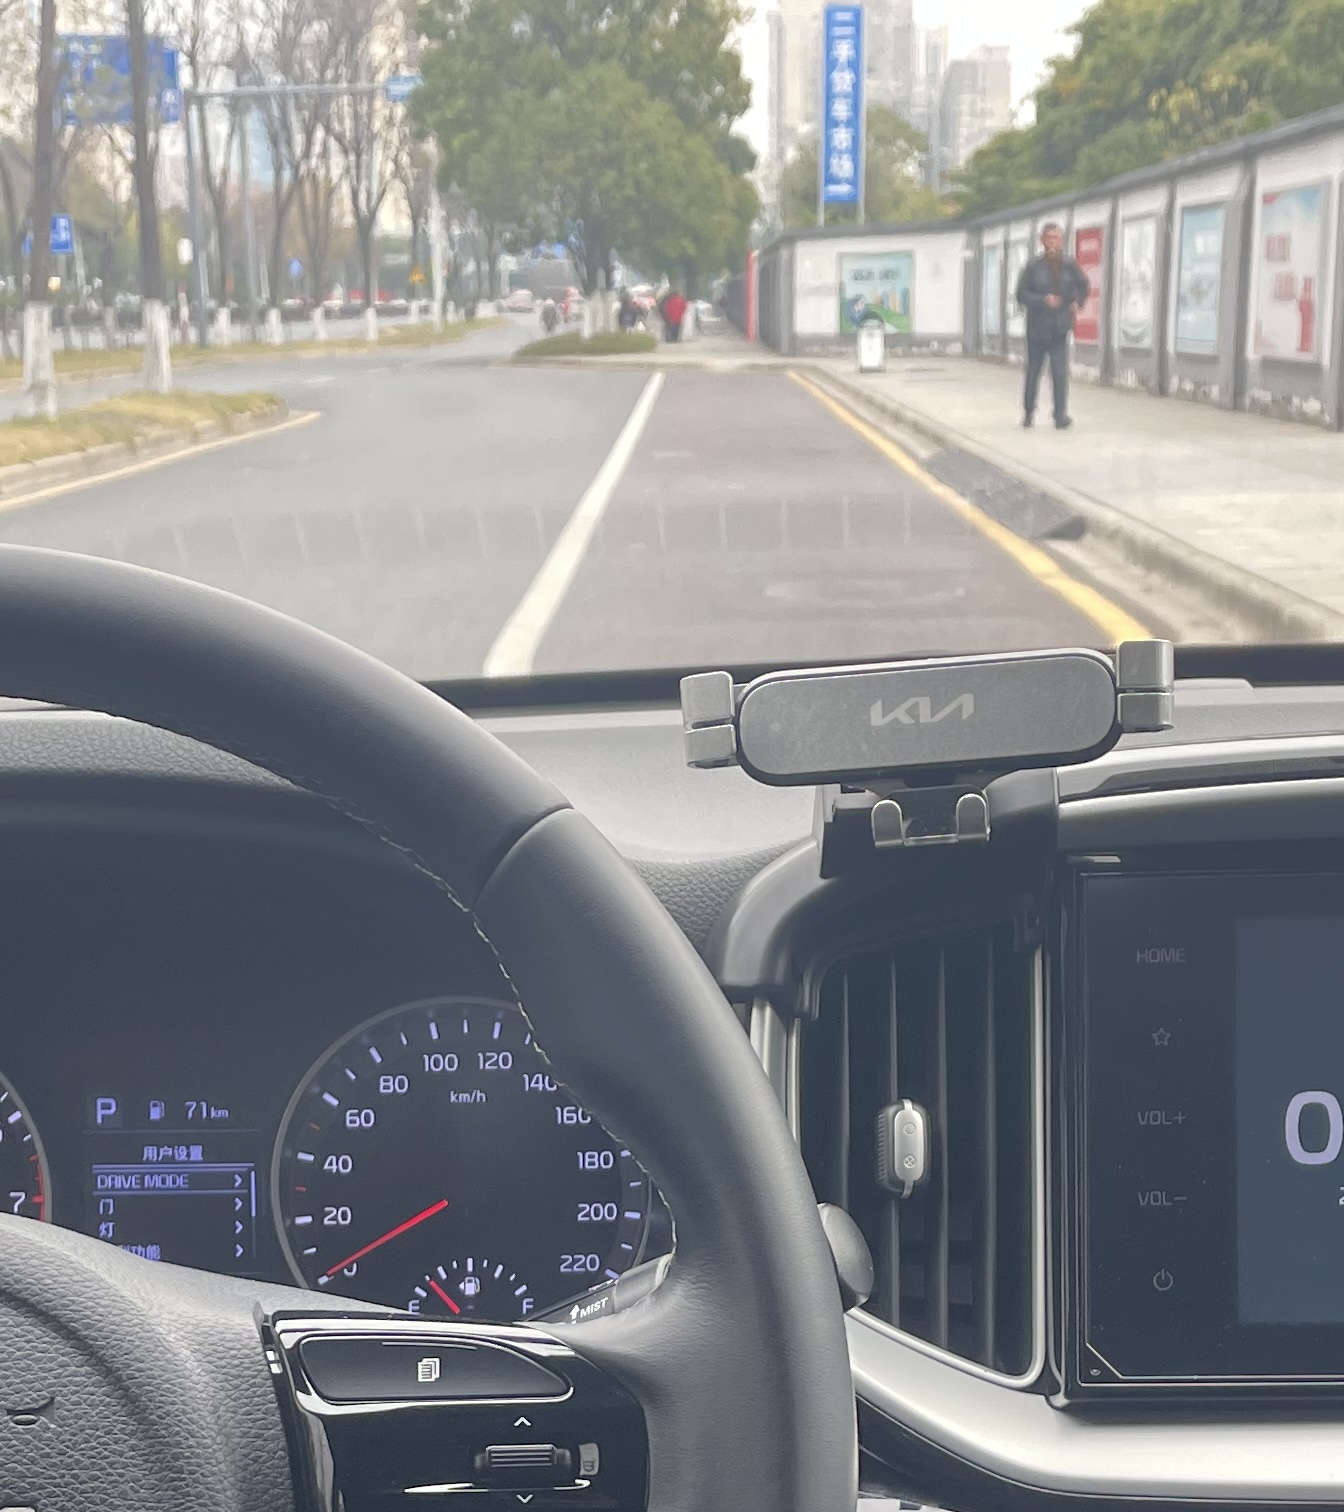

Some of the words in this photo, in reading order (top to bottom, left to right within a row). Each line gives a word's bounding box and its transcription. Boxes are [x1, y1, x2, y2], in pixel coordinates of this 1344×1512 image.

[869, 693, 974, 727] KIA
[1136, 948, 1185, 964] HOME
[423, 1053, 459, 1072] 100
[477, 1051, 513, 1070] 120
[379, 1075, 409, 1094] 80
[450, 1089, 486, 1103] km/h
[96, 1098, 117, 1124] P
[345, 1109, 375, 1128] 60
[1137, 1110, 1186, 1126] VOL+
[142, 1145, 204, 1162] 用户设置
[577, 1150, 614, 1169] 180
[323, 1155, 353, 1174] 40
[97, 1174, 141, 1189] DRIVE
[144, 1174, 189, 1188] MODE
[7, 1191, 26, 1214] 7
[99, 1198, 114, 1215] 门
[577, 1202, 618, 1221] 200
[323, 1206, 352, 1225] 20
[99, 1221, 115, 1238] 灯
[560, 1253, 600, 1273] 220
[407, 1299, 420, 1315] E
[522, 1298, 534, 1315] F
[579, 1296, 609, 1319] MIST
